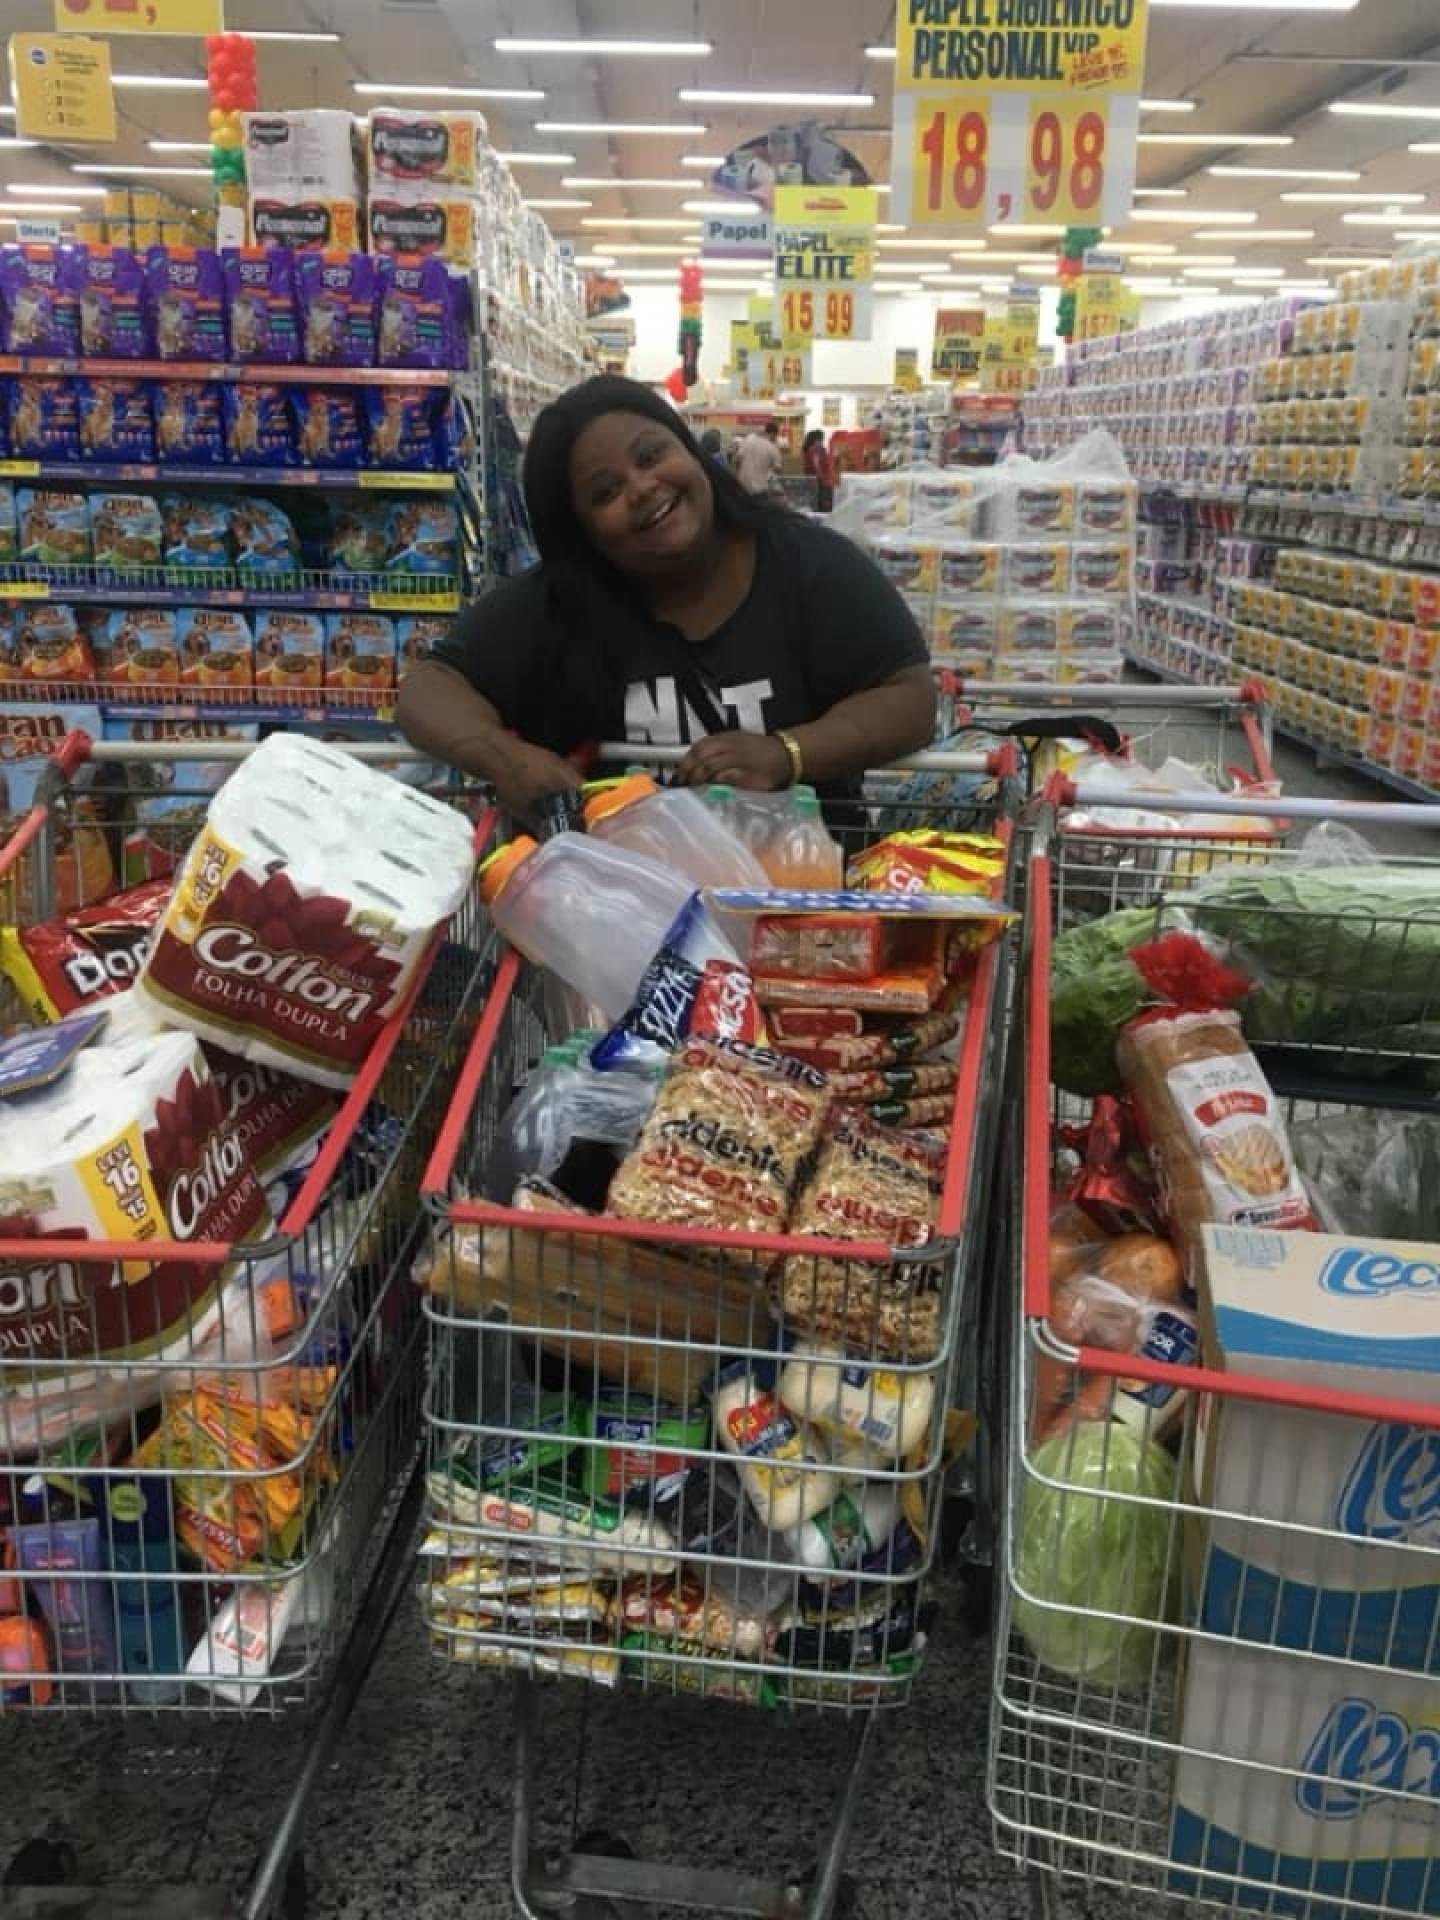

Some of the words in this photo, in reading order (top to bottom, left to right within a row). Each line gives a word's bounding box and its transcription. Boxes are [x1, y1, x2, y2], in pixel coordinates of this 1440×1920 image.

[913, 30, 1064, 80] PERSONAL
[1064, 33, 1100, 53] VIP
[708, 221, 767, 242] Papel
[777, 256, 856, 280] ELITE
[65, 938, 150, 997] Dor
[195, 926, 372, 1024] Cotton
[193, 968, 268, 1010] FOLHA
[273, 998, 348, 1042] DUPLA
[1319, 1247, 1440, 1297] Lec
